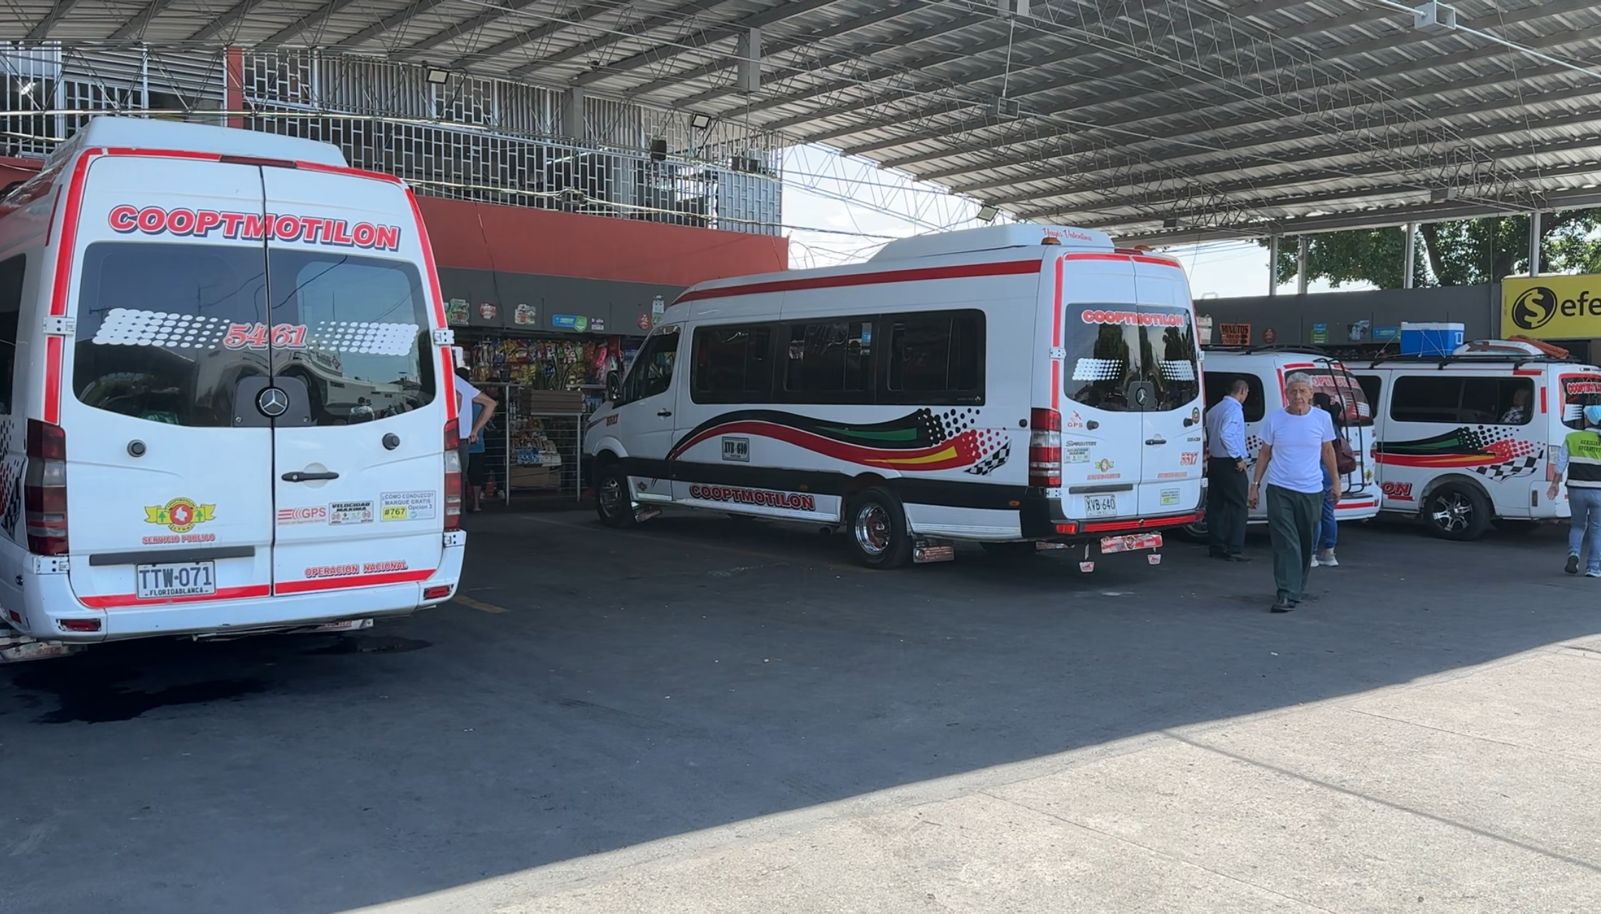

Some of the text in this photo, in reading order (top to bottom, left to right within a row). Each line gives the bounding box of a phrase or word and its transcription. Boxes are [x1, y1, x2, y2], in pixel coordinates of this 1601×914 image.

[108, 205, 400, 251] COOPTMOTILON
[1081, 309, 1185, 327] COOPTMOTILON
[223, 323, 308, 350] 5461
[689, 484, 816, 512] COOPTMOTILON
[302, 507, 327, 519] GPS
[364, 560, 408, 574] NACIONAL
[149, 587, 204, 596] FLORIDABLANCA
